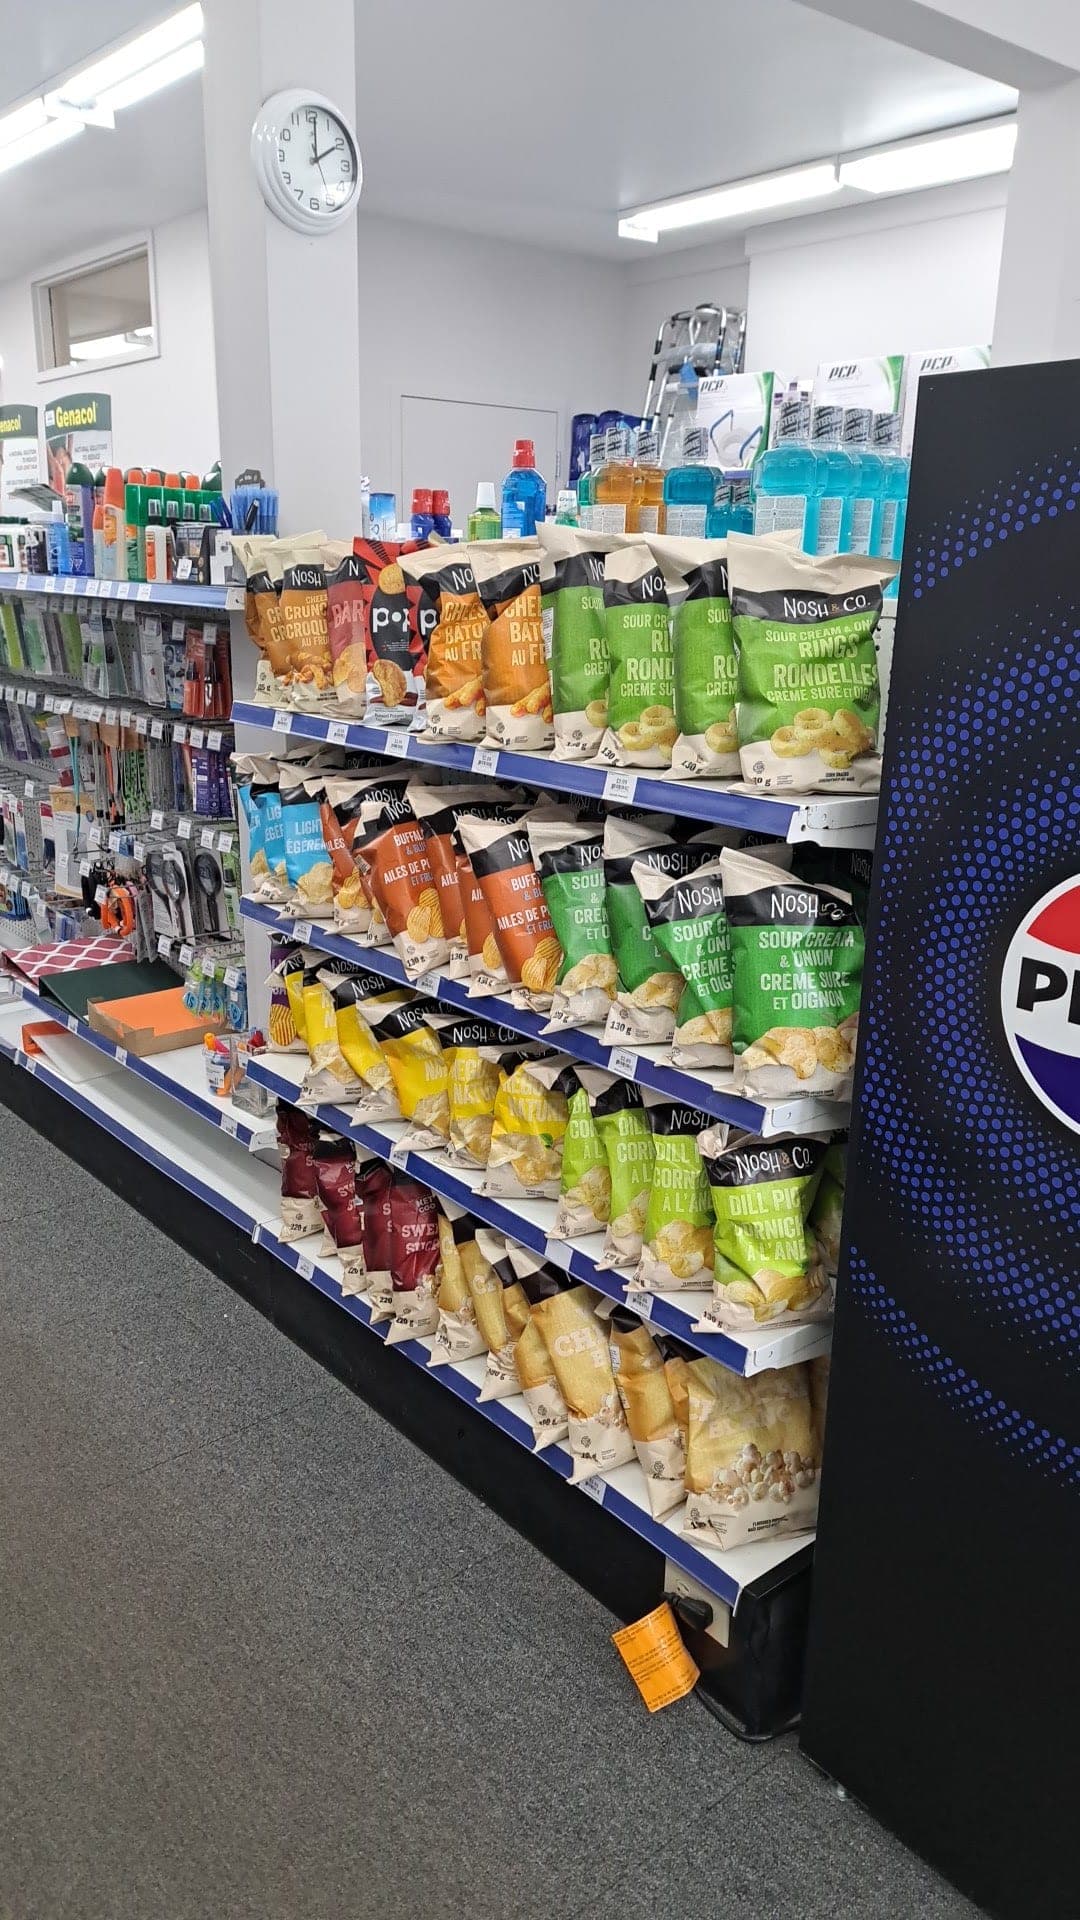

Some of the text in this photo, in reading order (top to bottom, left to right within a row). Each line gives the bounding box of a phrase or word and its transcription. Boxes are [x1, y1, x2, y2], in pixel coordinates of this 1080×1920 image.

[291, 112, 300, 126] 11
[334, 138, 345, 151] 2
[340, 159, 350, 173] 3
[293, 188, 303, 201] 7
[309, 198, 319, 211] 6
[829, 365, 857, 379] PCP
[921, 356, 953, 371] PCP
[701, 379, 724, 392] PCP
[0, 414, 21, 433] enacol
[56, 400, 97, 428] Genacol
[292, 568, 322, 587] NOSH
[452, 567, 474, 591] NO
[522, 564, 540, 587] NO
[589, 557, 605, 582] NO
[642, 574, 665, 599] NO
[267, 606, 281, 624] CR
[285, 602, 328, 621] CRUNC
[332, 599, 364, 629] BAR
[443, 600, 485, 622] CHEES
[504, 595, 542, 619] CHE
[783, 596, 828, 619] NOSH
[287, 620, 328, 638] CROQU
[622, 614, 669, 628] SOUR CR
[765, 629, 798, 643] SOUR
[799, 626, 842, 642] CREAM
[853, 618, 872, 634] ON
[509, 618, 543, 644] BÂT
[444, 639, 482, 662] AU FR
[589, 638, 610, 660] RO
[799, 632, 860, 659] RINGS
[511, 649, 526, 667] AU
[713, 655, 739, 680] RO
[658, 681, 674, 697] SU
[811, 685, 843, 700] SURE
[843, 687, 854, 699] ET
[266, 804, 282, 821] LIG
[387, 799, 413, 821] NOS
[507, 838, 530, 862] NO
[580, 844, 601, 867] NO
[383, 861, 421, 885] AILES DE
[511, 873, 541, 892] BUFF
[471, 887, 484, 902] AIL
[590, 891, 600, 905] &
[676, 885, 723, 914] NOSH
[770, 893, 819, 919] NOSH
[525, 908, 539, 925] DE
[586, 928, 599, 941] ET
[673, 919, 714, 943] SOUR
[758, 930, 855, 950] SOUR CREAM
[406, 956, 420, 967] 130
[451, 953, 463, 962] 130
[779, 949, 834, 969] & ONION
[351, 975, 386, 1001] NOSH
[709, 973, 733, 994] OIG
[820, 970, 851, 988] SURE
[773, 989, 846, 1011] ET OIGNON
[453, 1025, 487, 1043] NOSH
[609, 1020, 625, 1033] 130
[670, 1109, 711, 1131] NOSH
[656, 1142, 691, 1162] DILL
[734, 1151, 781, 1179] NOSH
[780, 1151, 793, 1167] &
[416, 1196, 435, 1209] KET
[418, 1202, 437, 1214] COO
[729, 1186, 800, 1216] DILL PIC
[396, 1316, 408, 1325] 220
